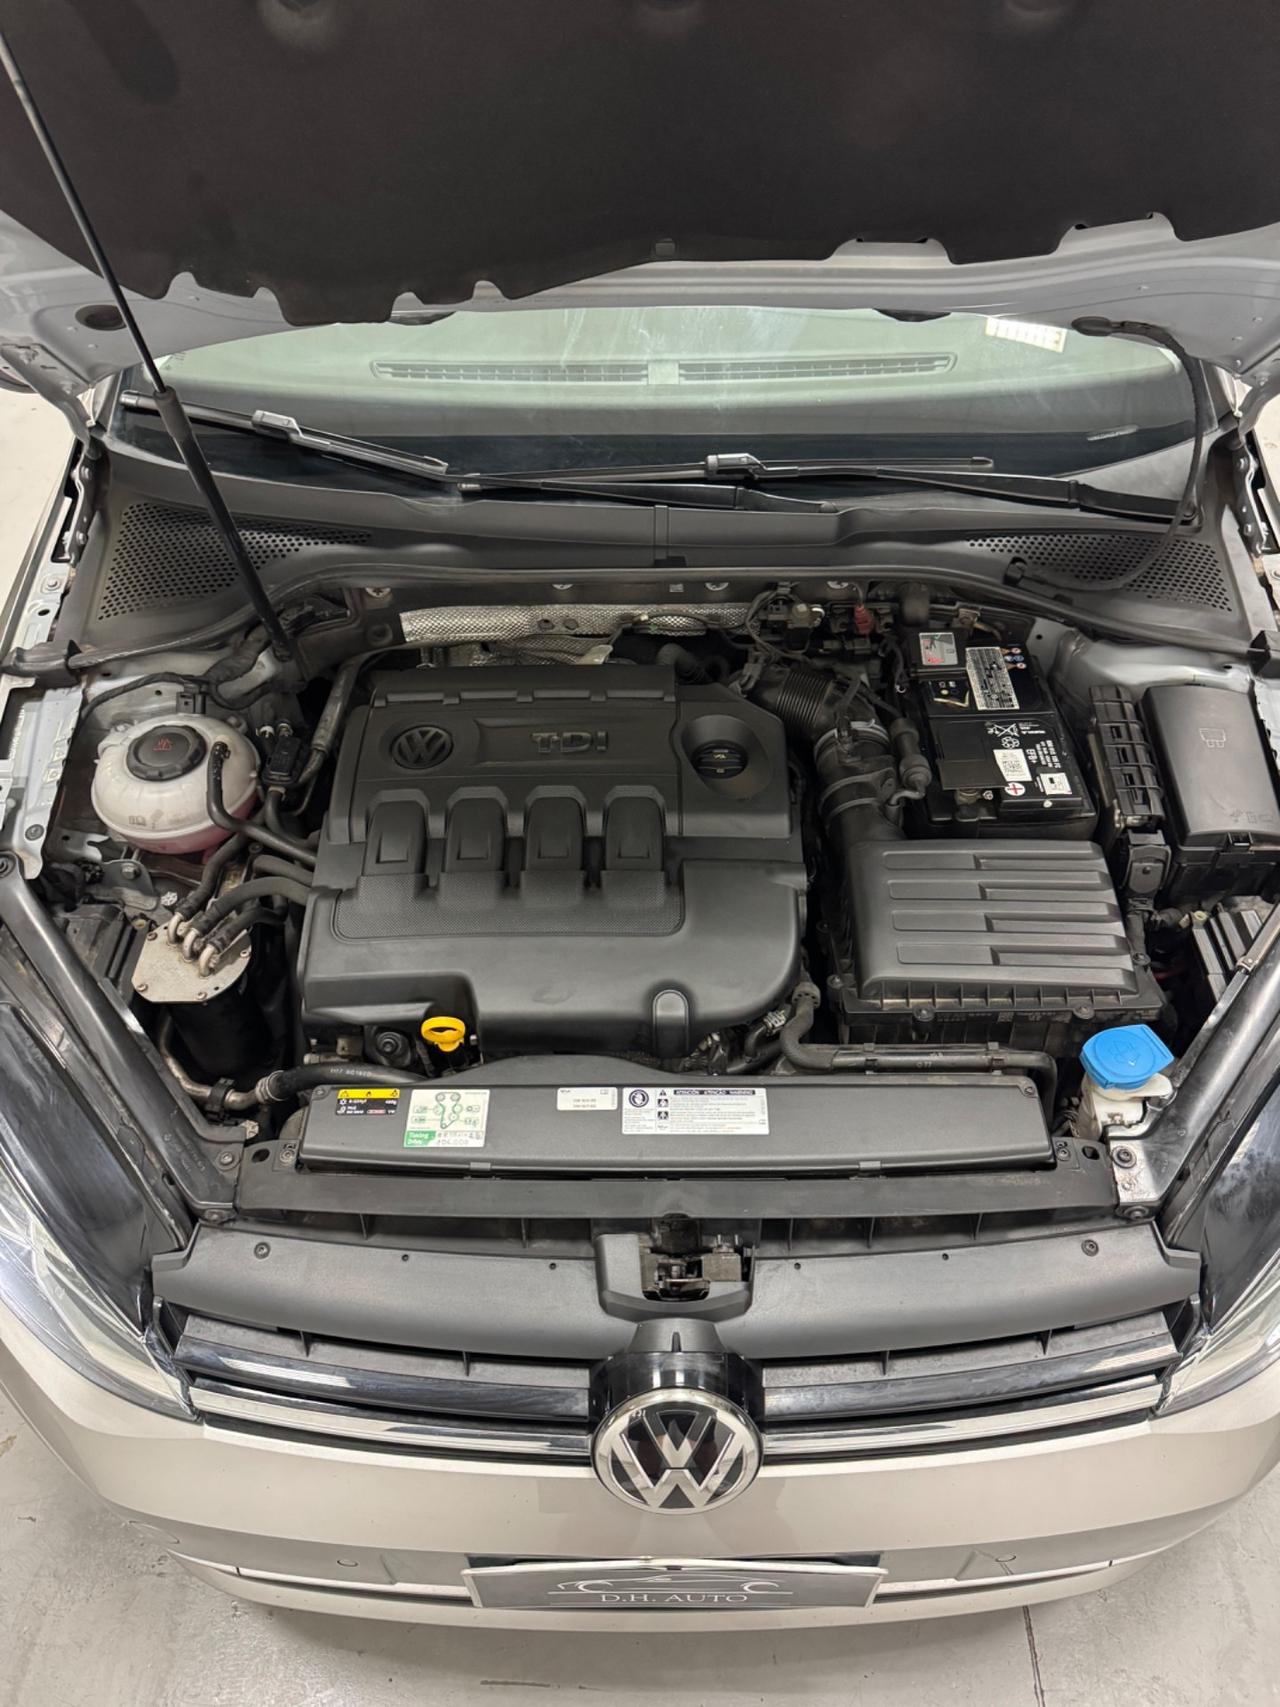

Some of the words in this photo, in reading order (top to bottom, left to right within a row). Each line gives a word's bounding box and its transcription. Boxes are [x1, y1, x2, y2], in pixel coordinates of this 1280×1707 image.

[530, 731, 609, 753] TDI
[595, 1391, 761, 1515] VW
[601, 1594, 656, 1602] D.H.
[664, 1594, 748, 1602] AUTO
